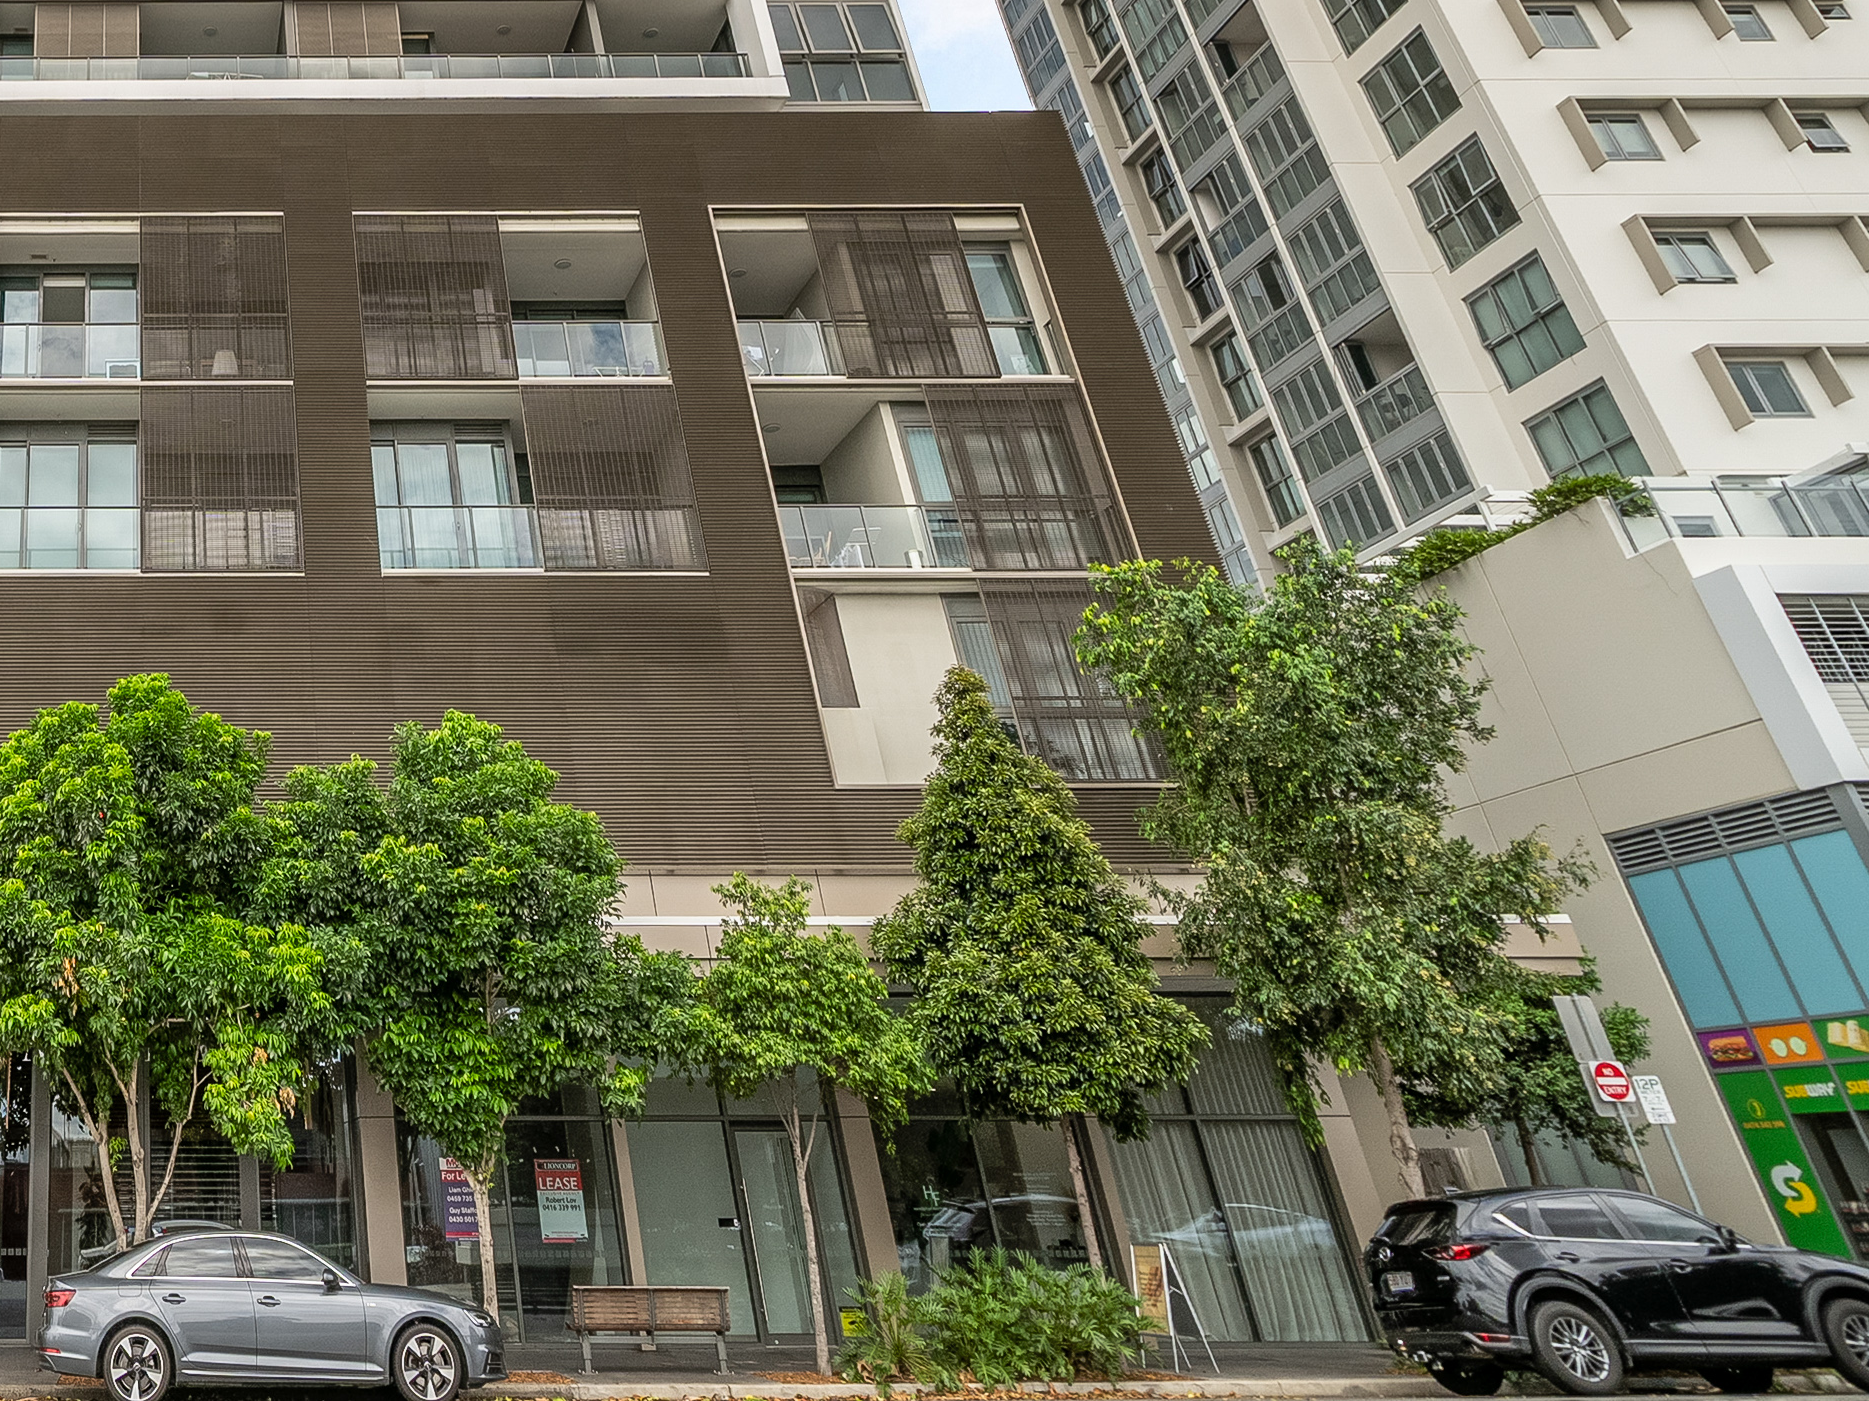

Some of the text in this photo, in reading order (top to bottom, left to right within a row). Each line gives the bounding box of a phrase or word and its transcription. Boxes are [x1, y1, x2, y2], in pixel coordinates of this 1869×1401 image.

[1602, 1068, 1615, 1076] NO
[1634, 1079, 1659, 1089] 12P
[1845, 1080, 1869, 1095] SUB
[1602, 1086, 1627, 1095] ENTRY
[1783, 1082, 1836, 1098] SUBWAY
[441, 1171, 455, 1181] For
[538, 1177, 578, 1190] LEASE
